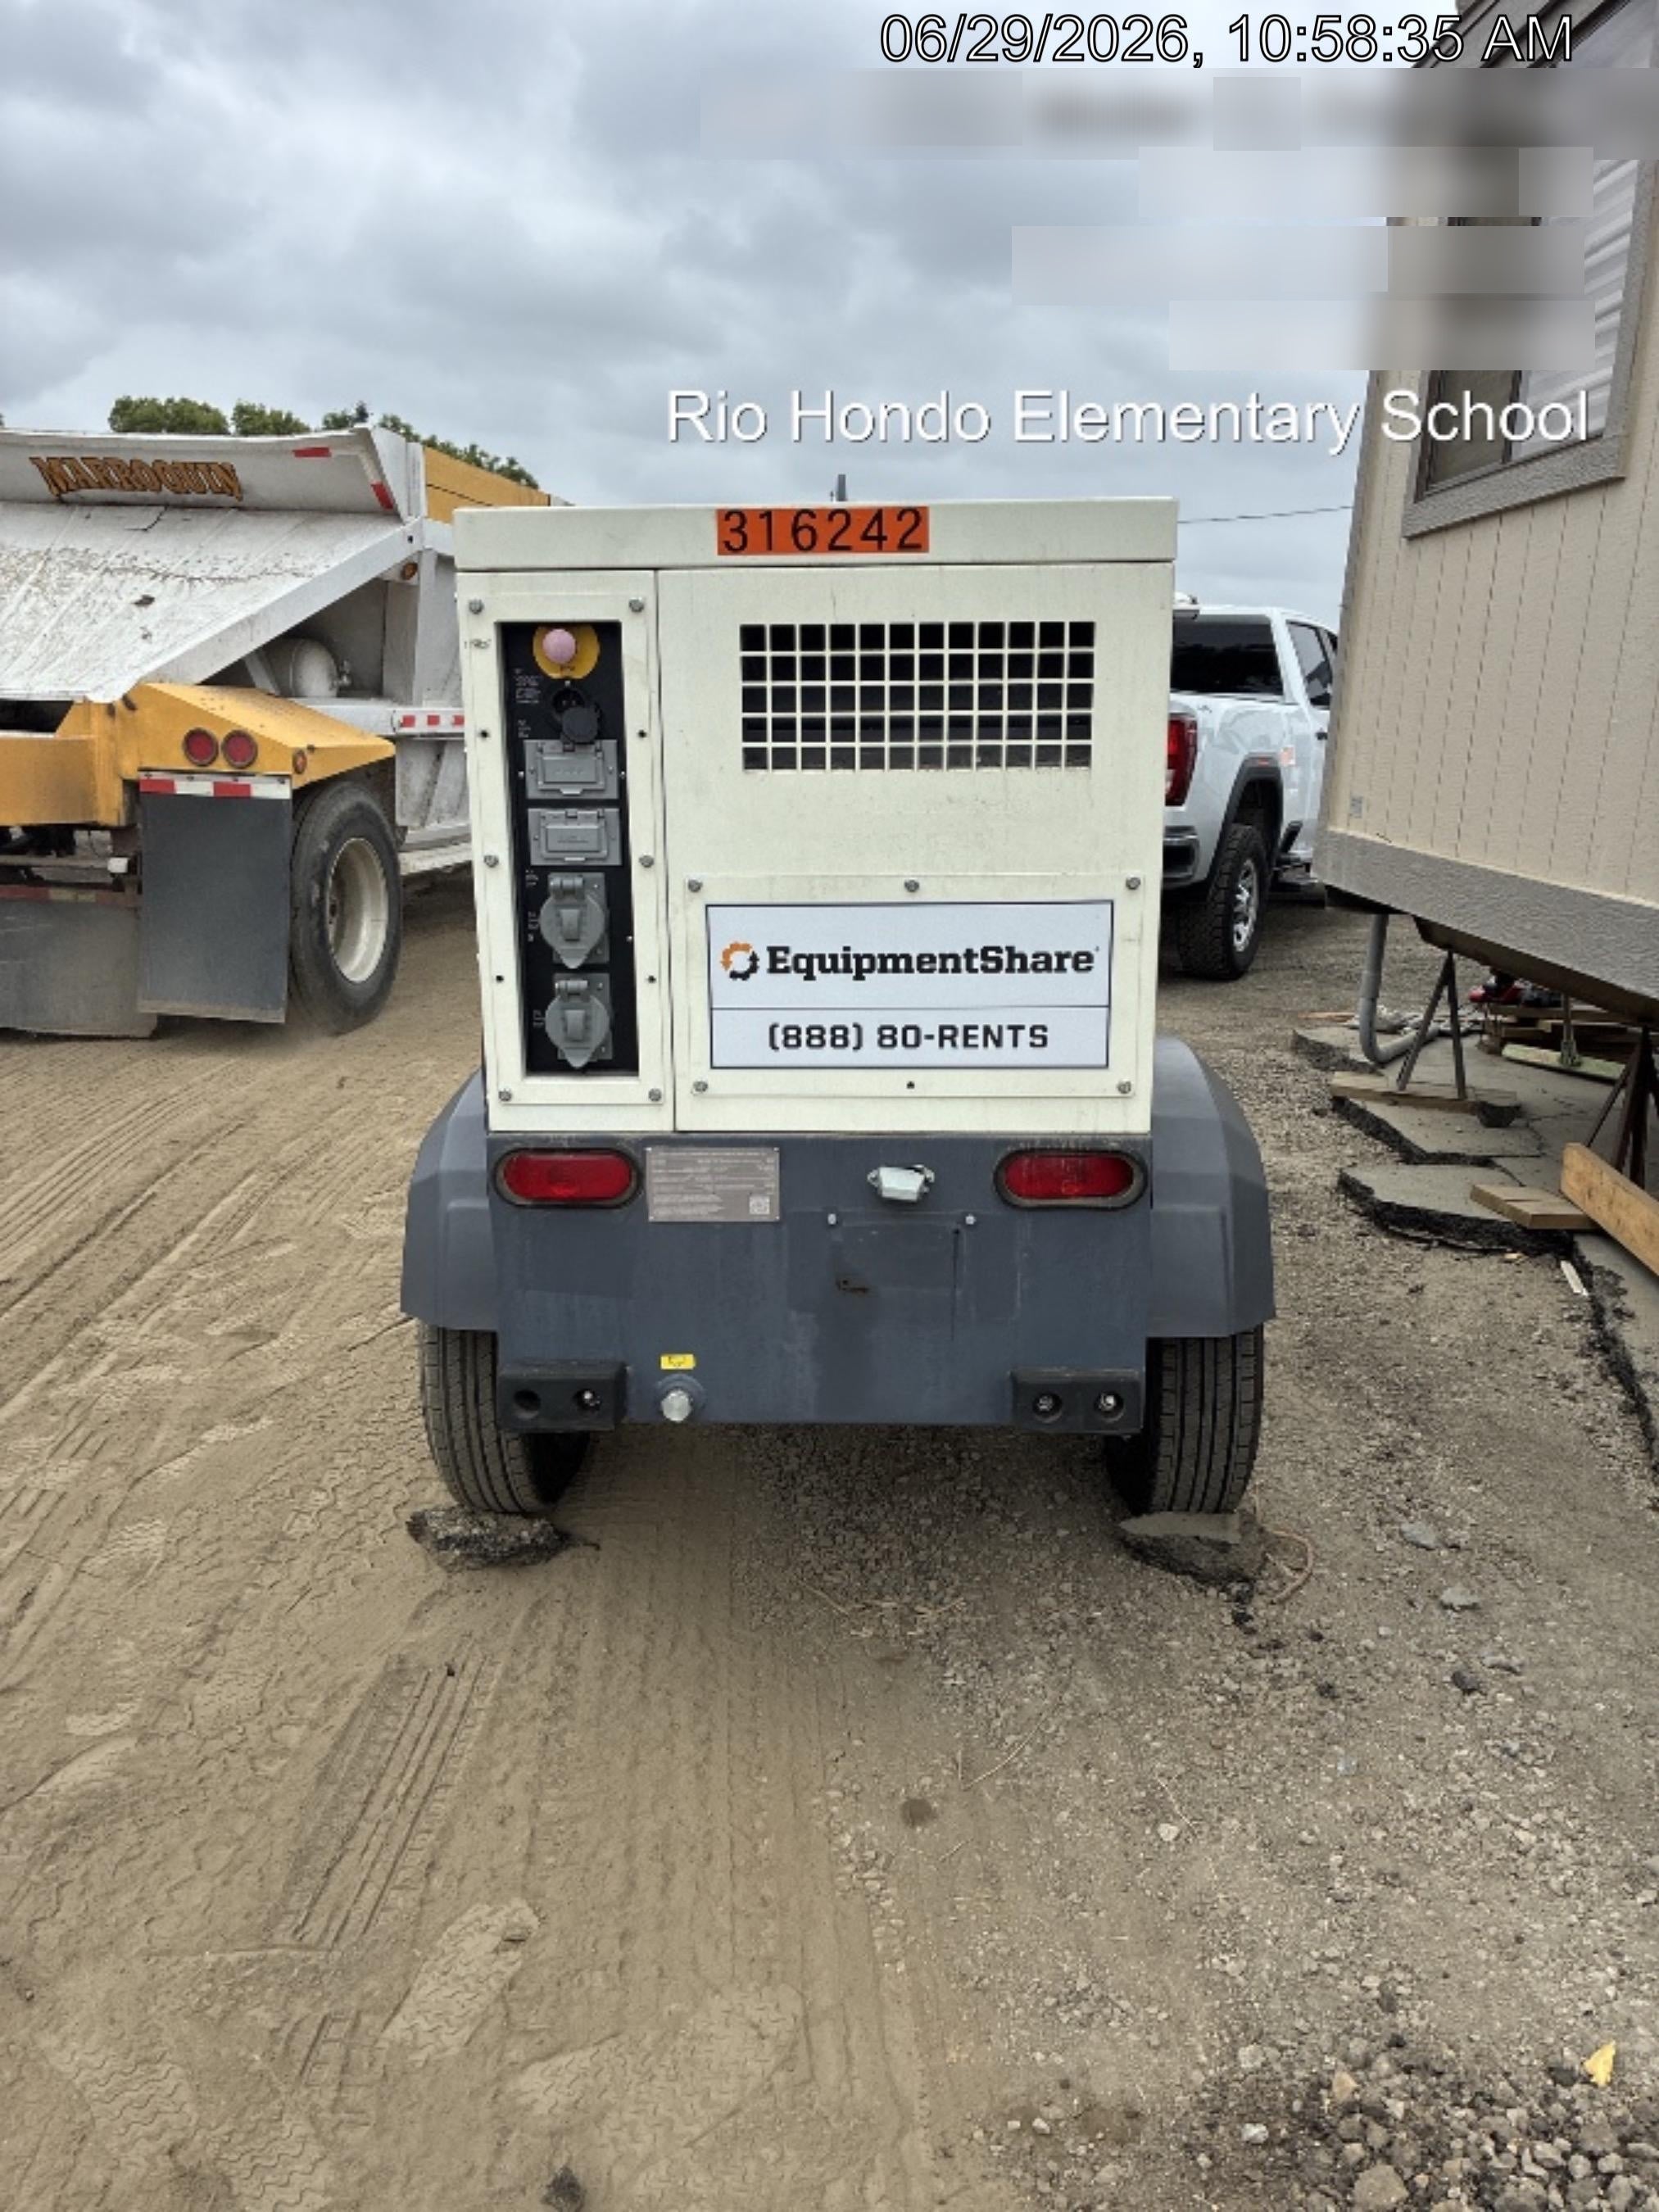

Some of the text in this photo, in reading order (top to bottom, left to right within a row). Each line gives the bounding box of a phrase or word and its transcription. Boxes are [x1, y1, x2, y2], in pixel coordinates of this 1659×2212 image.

[723, 508, 922, 552] 316242
[766, 945, 1095, 981] EquipmentShare
[768, 1022, 1049, 1051] (888) 80-RENTS
